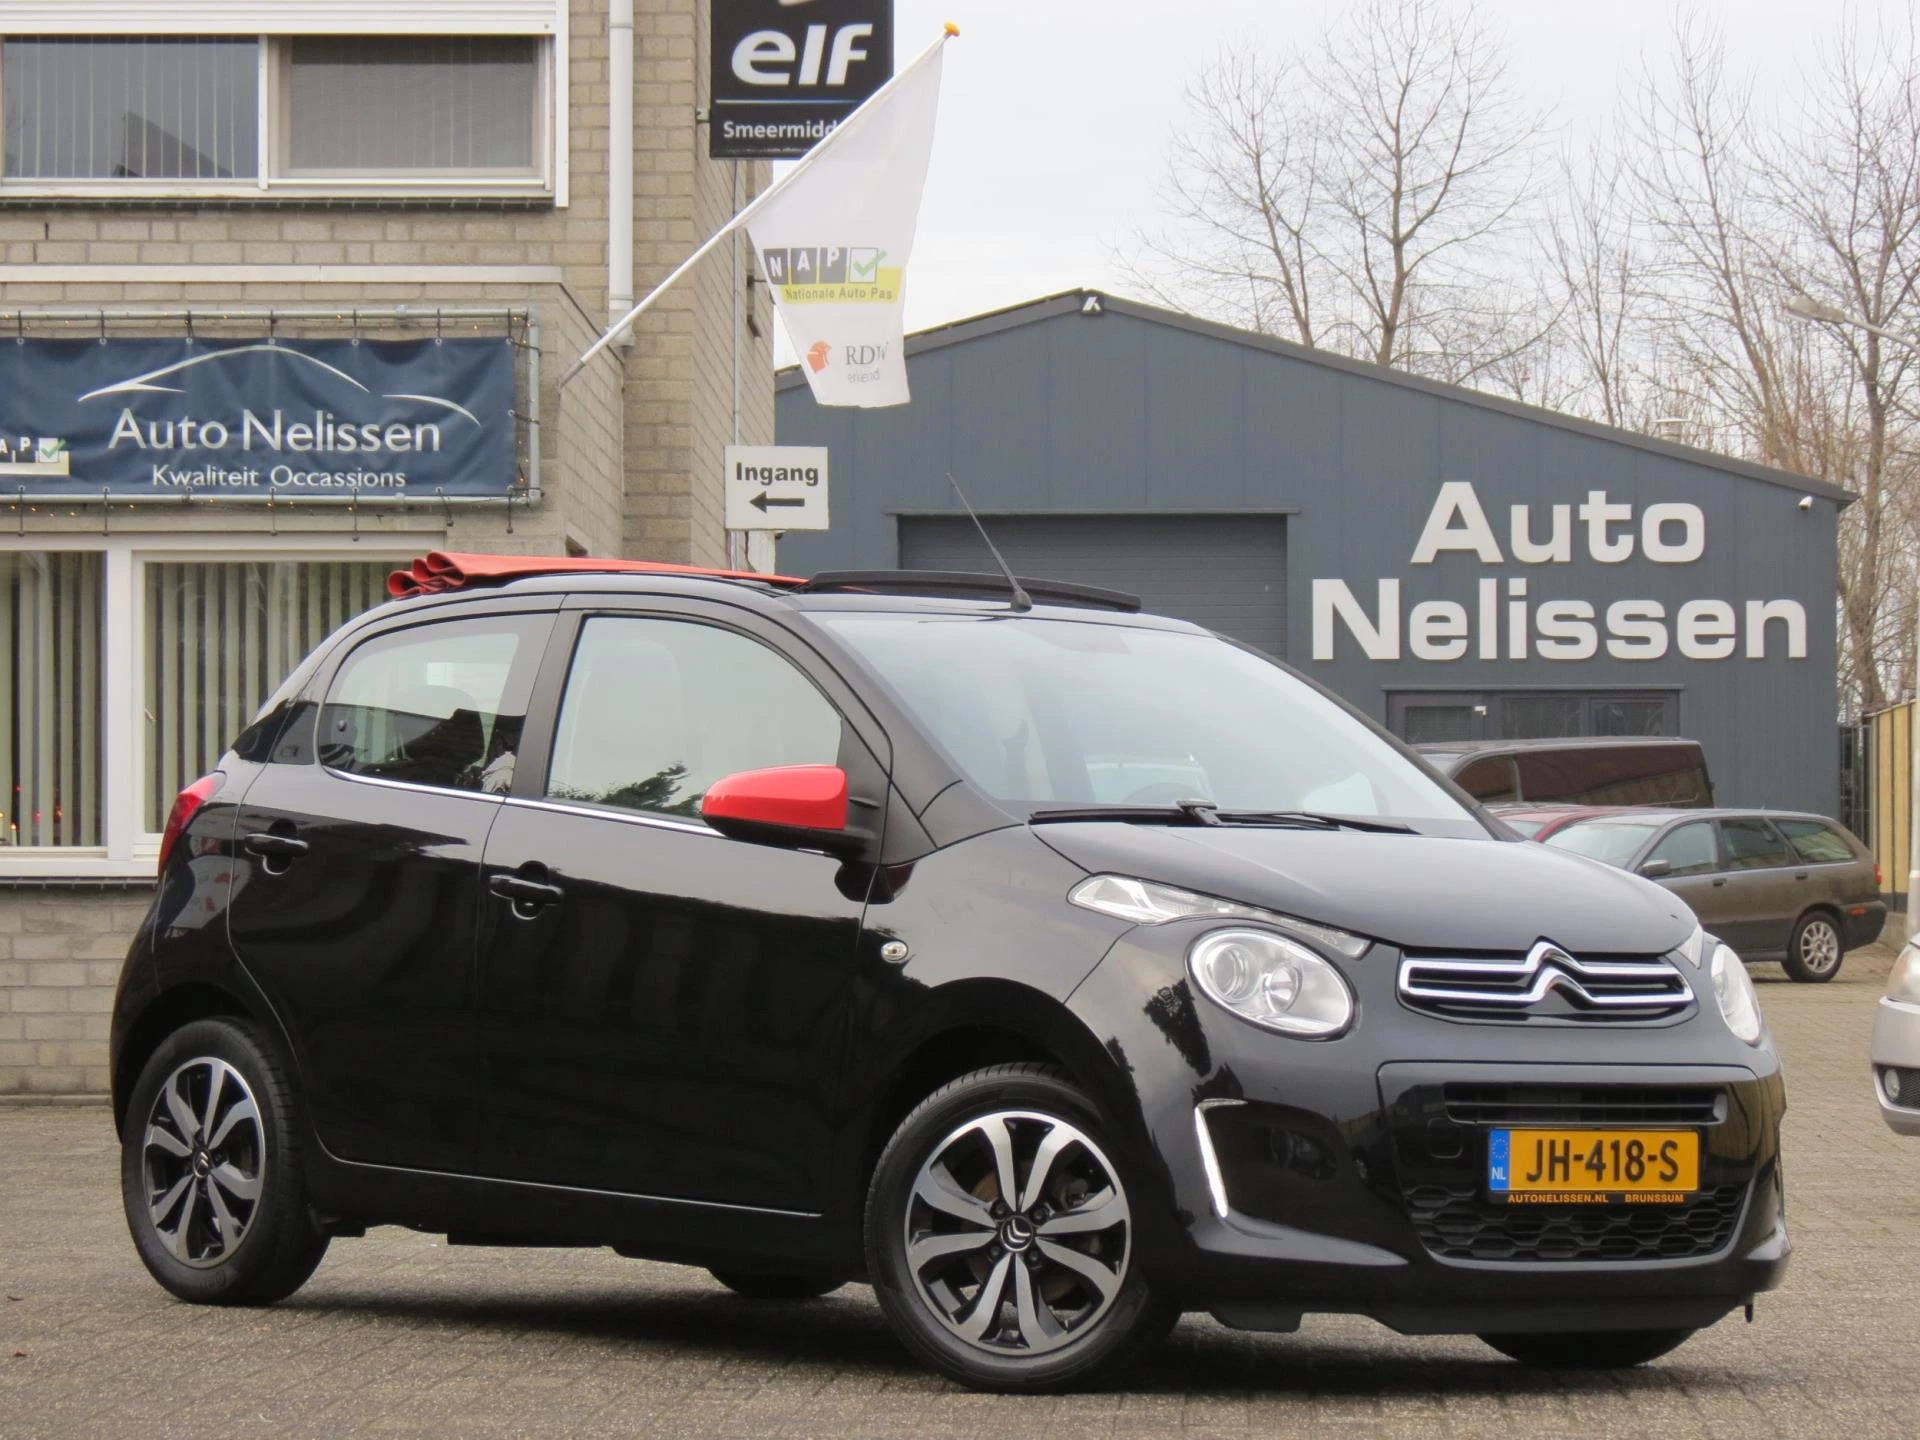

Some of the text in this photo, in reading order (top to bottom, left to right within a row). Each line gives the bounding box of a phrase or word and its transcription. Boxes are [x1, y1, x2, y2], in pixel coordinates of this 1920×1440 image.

[732, 23, 873, 85] elf
[785, 287, 893, 300] Nationale Auto Pas
[108, 408, 440, 452] Auto Nelissen
[152, 464, 407, 488] Kwaliteit Occassions
[736, 462, 819, 486] Ingang
[1410, 481, 1706, 564] Auto
[1311, 577, 1808, 661] Nelissen
[1491, 1166, 1507, 1180] NL
[1526, 1139, 1679, 1183] JH-418-S
[1507, 1194, 1684, 1203] AUTONELISSEN.NL BRUNSSUM
